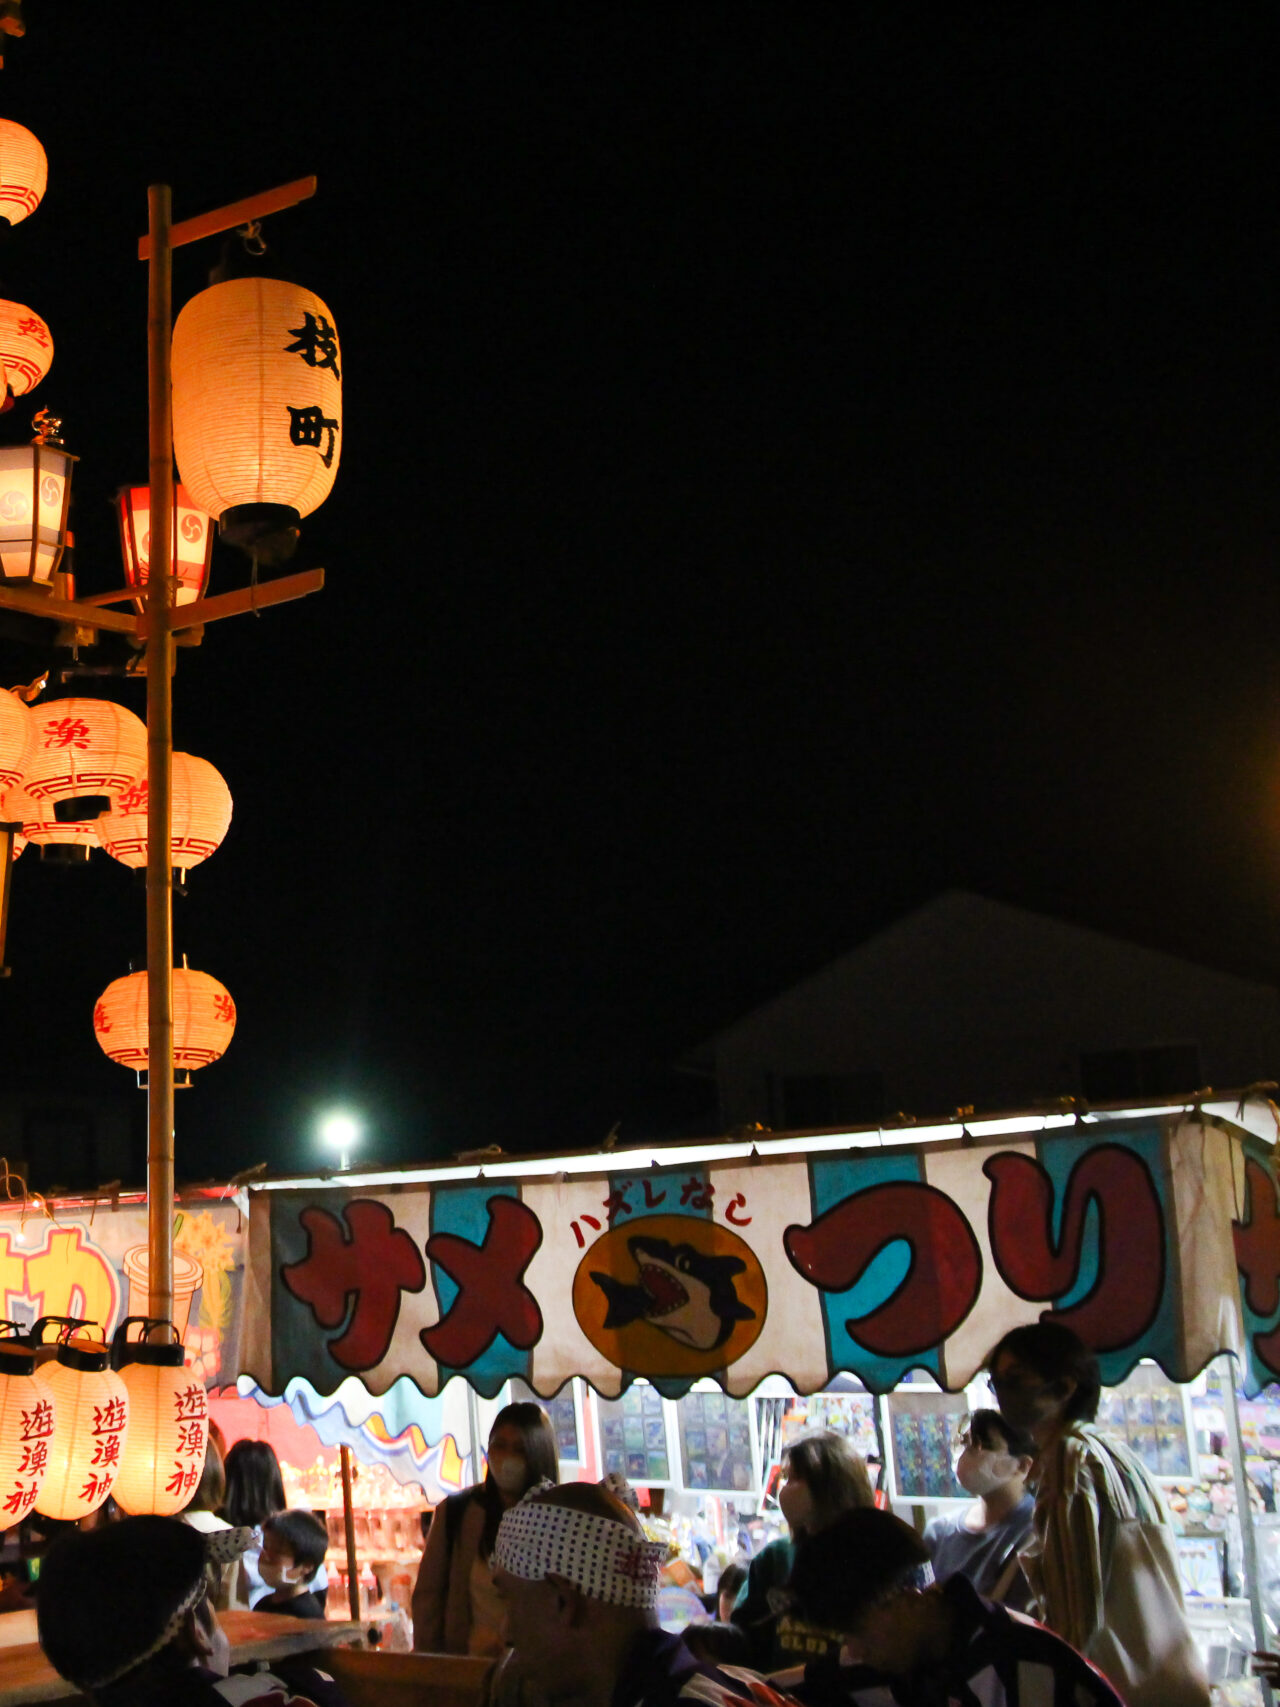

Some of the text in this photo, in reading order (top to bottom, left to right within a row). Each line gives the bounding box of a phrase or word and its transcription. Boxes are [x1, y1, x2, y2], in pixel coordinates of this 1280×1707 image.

[17, 316, 50, 348] 遊
[43, 717, 92, 750] 漁
[281, 1194, 545, 1371] サメ
[783, 1142, 1166, 1359] つり
[570, 1176, 753, 1249] ハズレなし
[2, 1398, 54, 1515] 遊漁神
[78, 1396, 127, 1504] 遊漁神
[165, 1383, 208, 1498] 遊漁神
